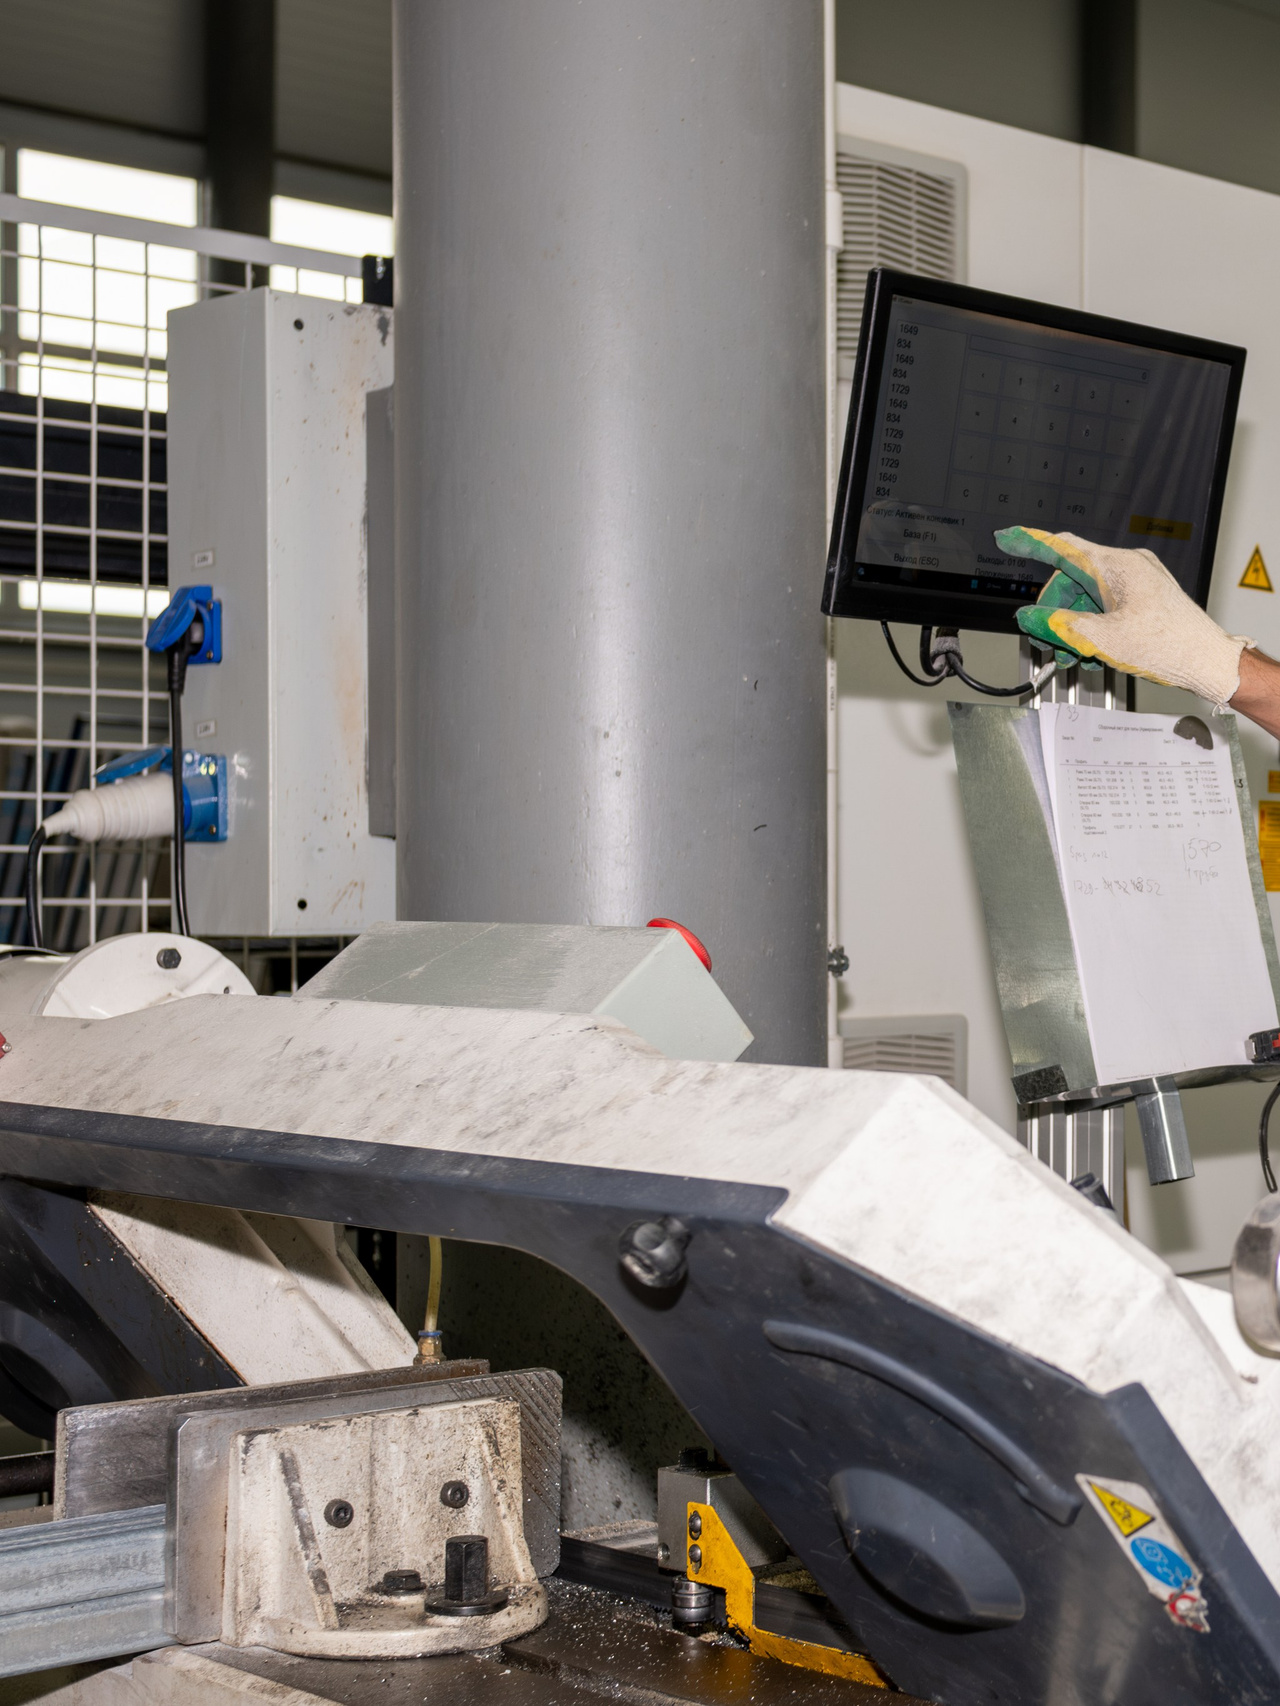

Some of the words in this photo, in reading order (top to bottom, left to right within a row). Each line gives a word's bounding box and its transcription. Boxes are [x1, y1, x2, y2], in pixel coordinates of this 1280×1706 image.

[900, 324, 918, 335] 1649
[896, 338, 911, 349] 834
[896, 353, 914, 365] 1649
[892, 368, 907, 379] 834
[892, 383, 910, 395] 1729
[889, 398, 908, 410] 1649
[886, 412, 901, 423] 834
[885, 428, 904, 439] 1729
[883, 443, 902, 454] 1570
[881, 457, 900, 469] 1729
[879, 472, 898, 484] 1649
[875, 486, 890, 497] 834
[895, 508, 926, 521] Активен
[903, 529, 922, 540] База
[922, 533, 938, 542] (F1)
[894, 553, 918, 566] Выход
[918, 556, 940, 568] (ESC)
